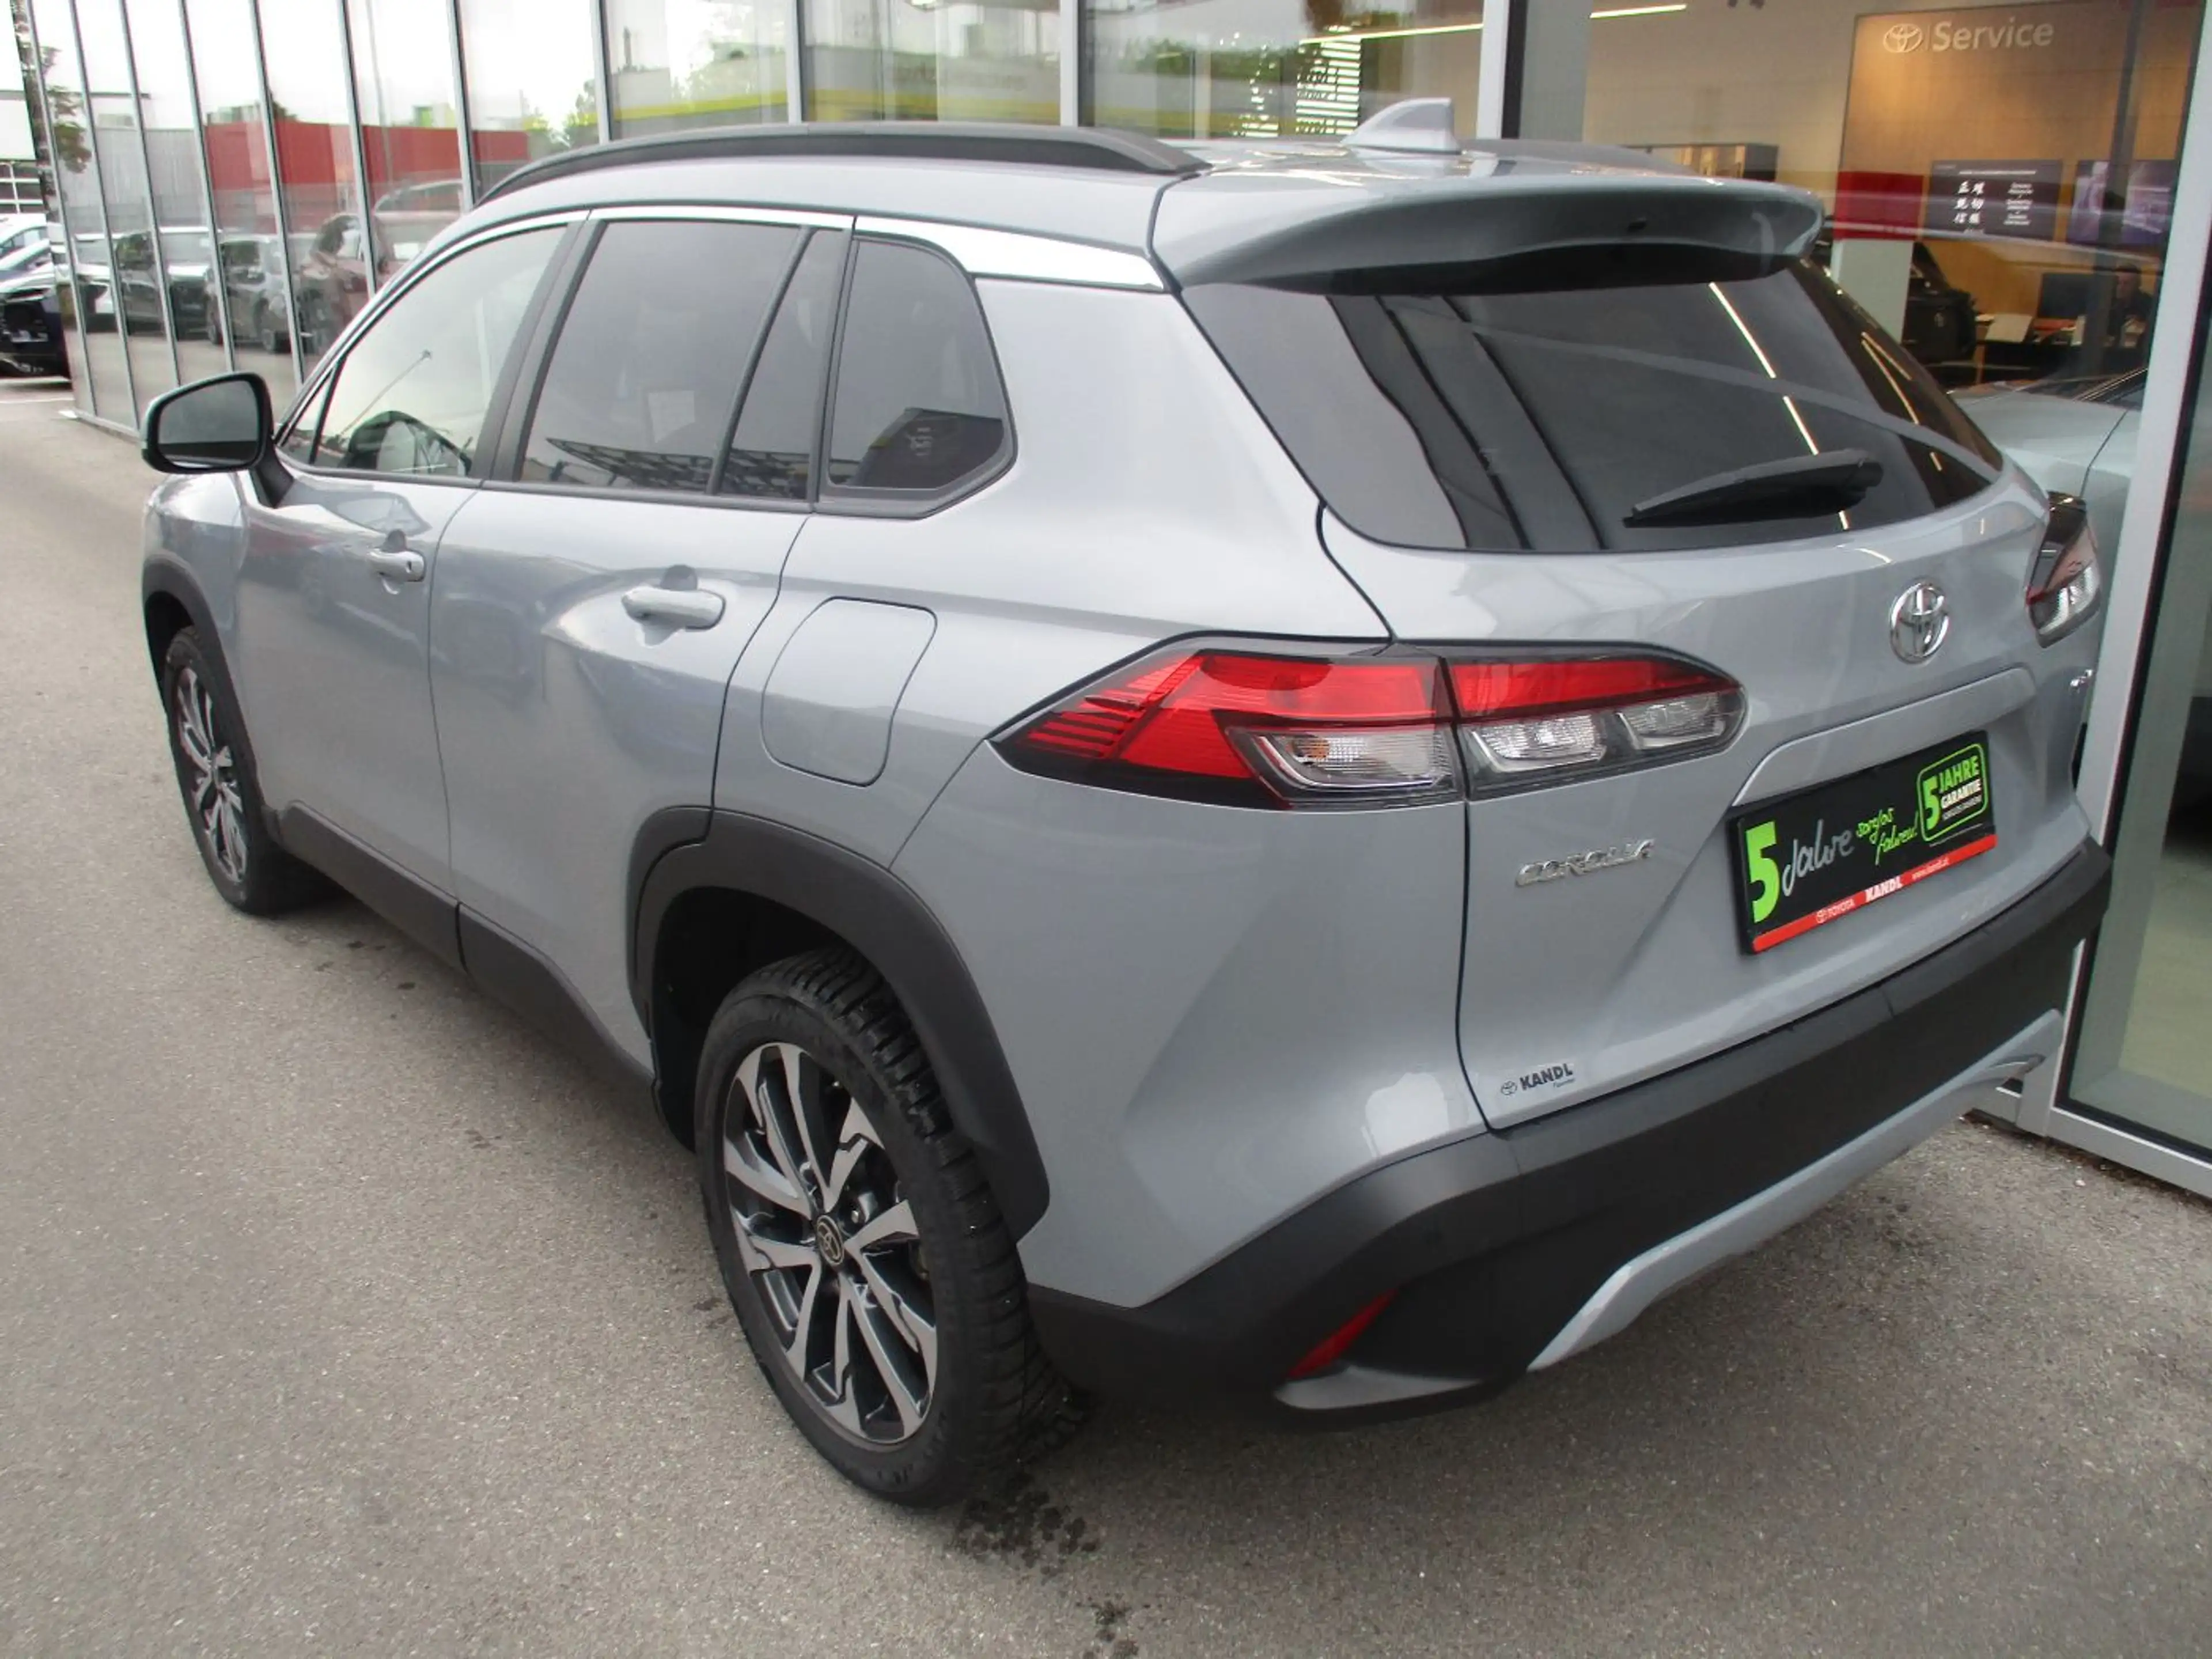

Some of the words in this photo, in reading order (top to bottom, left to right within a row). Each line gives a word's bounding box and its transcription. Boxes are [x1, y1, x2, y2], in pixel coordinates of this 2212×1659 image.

[1932, 17, 2054, 52] Service
[1922, 775, 1941, 831] 5
[1938, 755, 1980, 794] JAHRE
[1745, 821, 1781, 923] 5
[1782, 819, 1855, 897] Jahre
[1864, 875, 1904, 903] KANDL
[1519, 1063, 1574, 1091] KANDL
